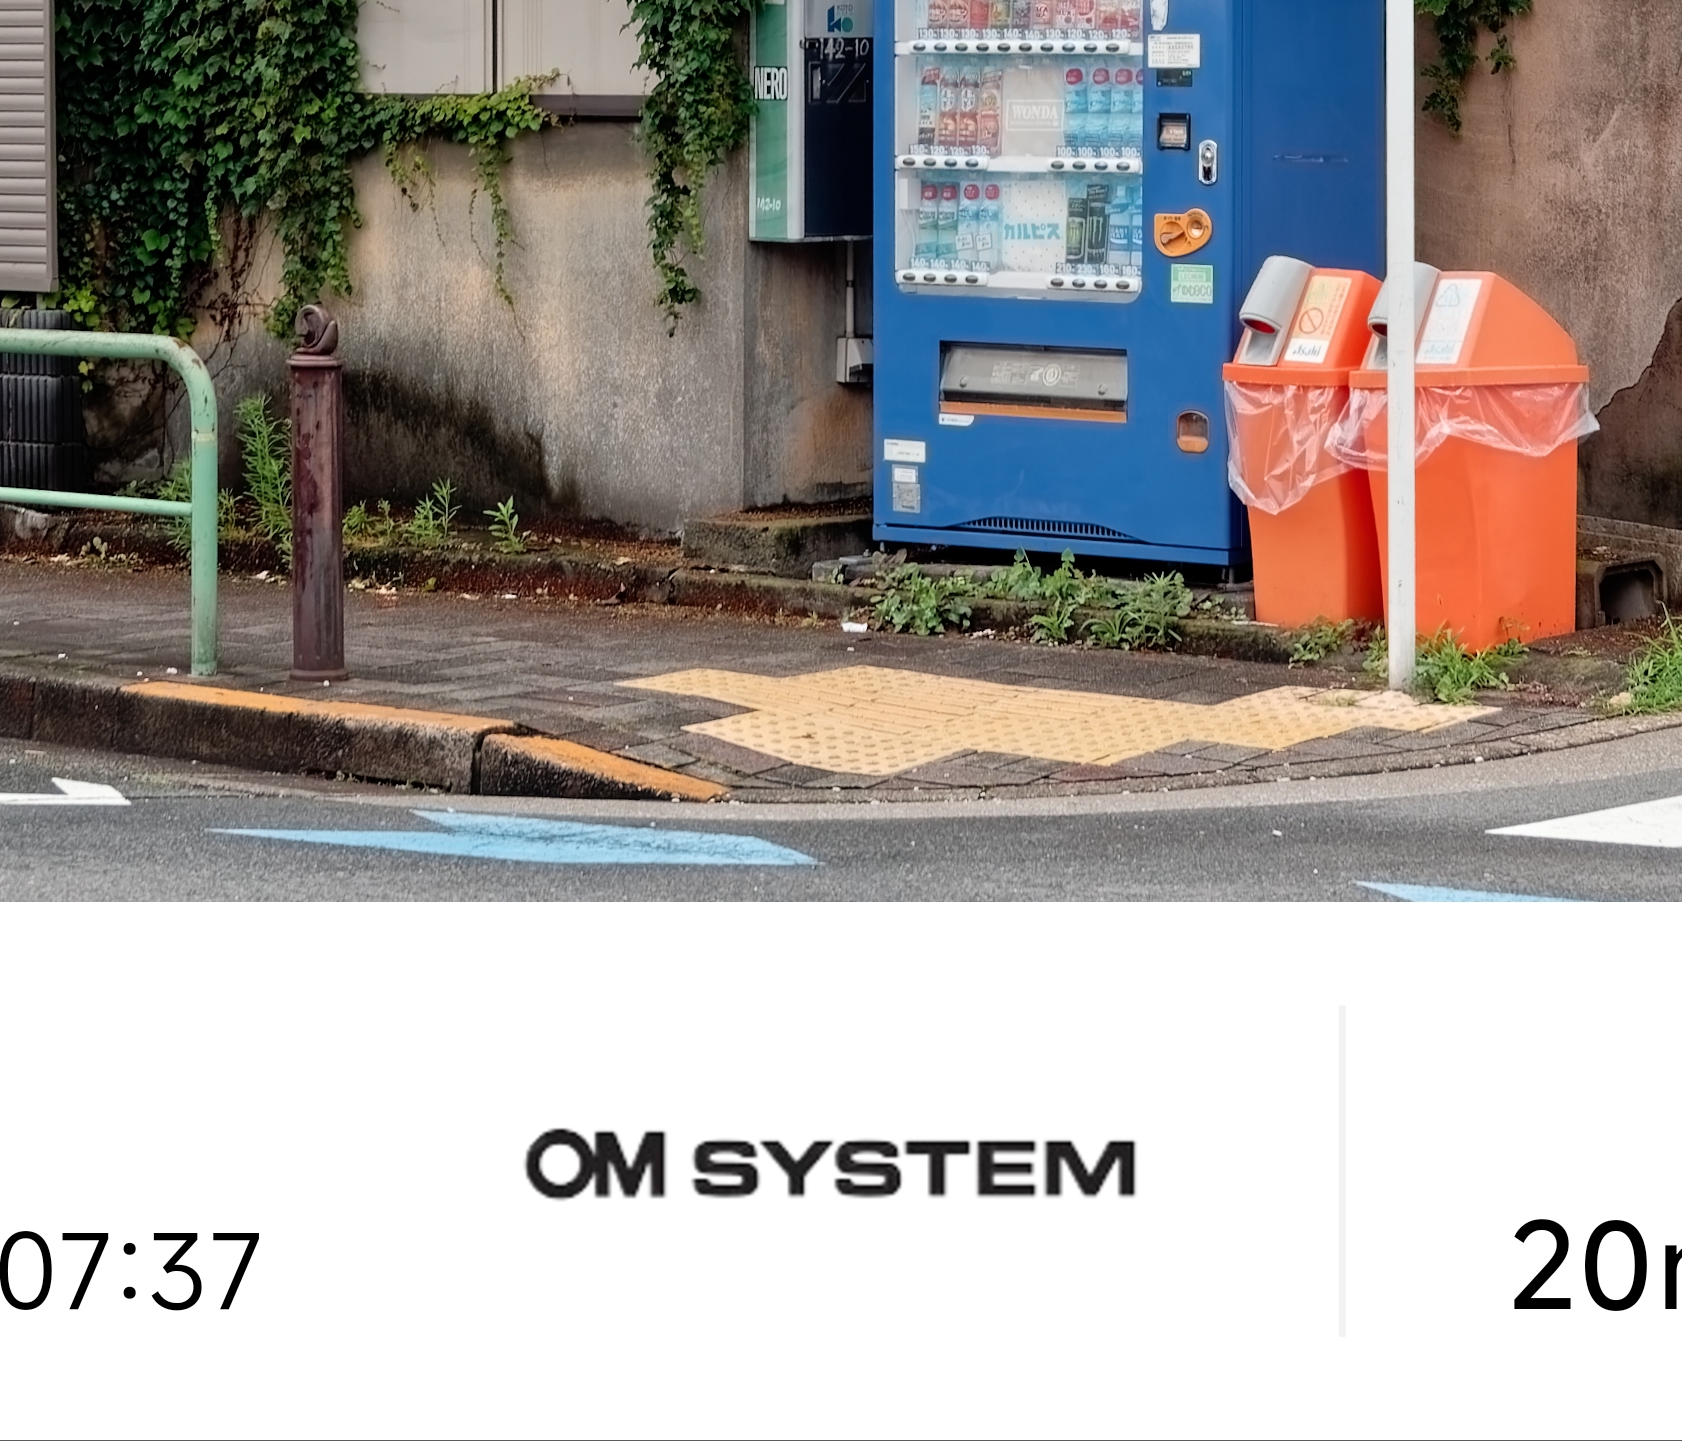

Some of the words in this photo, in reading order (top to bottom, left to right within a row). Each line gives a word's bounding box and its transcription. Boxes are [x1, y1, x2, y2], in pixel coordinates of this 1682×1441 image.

[820, 38, 870, 61] 142-10
[754, 67, 788, 100] NERO
[1012, 105, 1058, 120] WONDA
[1004, 223, 1061, 240] カルピス
[1292, 344, 1321, 357] Asahi
